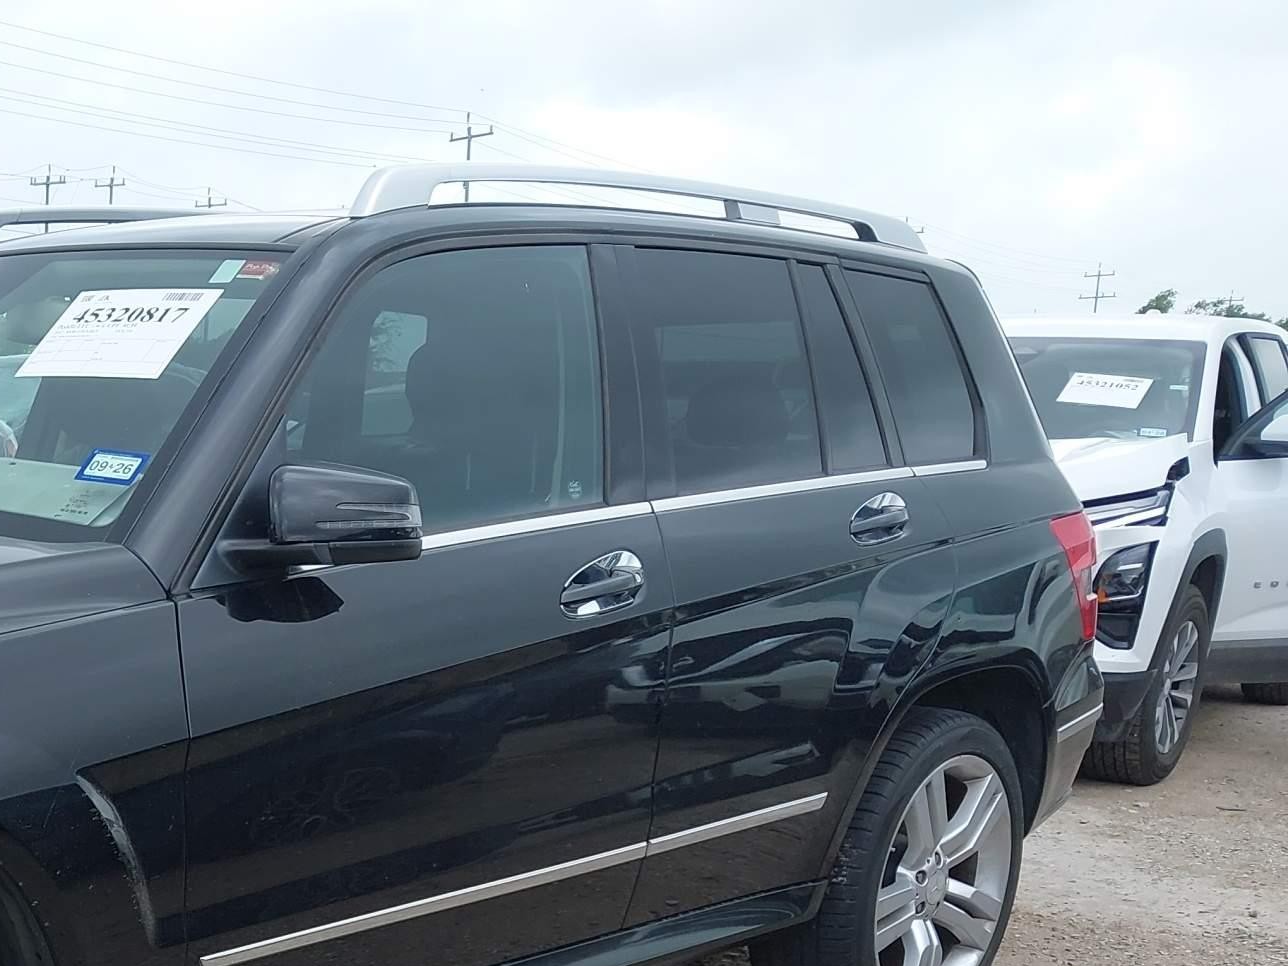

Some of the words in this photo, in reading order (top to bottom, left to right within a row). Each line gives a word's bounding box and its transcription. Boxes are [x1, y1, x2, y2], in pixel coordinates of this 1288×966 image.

[72, 306, 191, 323] 45320817
[88, 460, 109, 472] 09
[112, 462, 134, 475] 26
